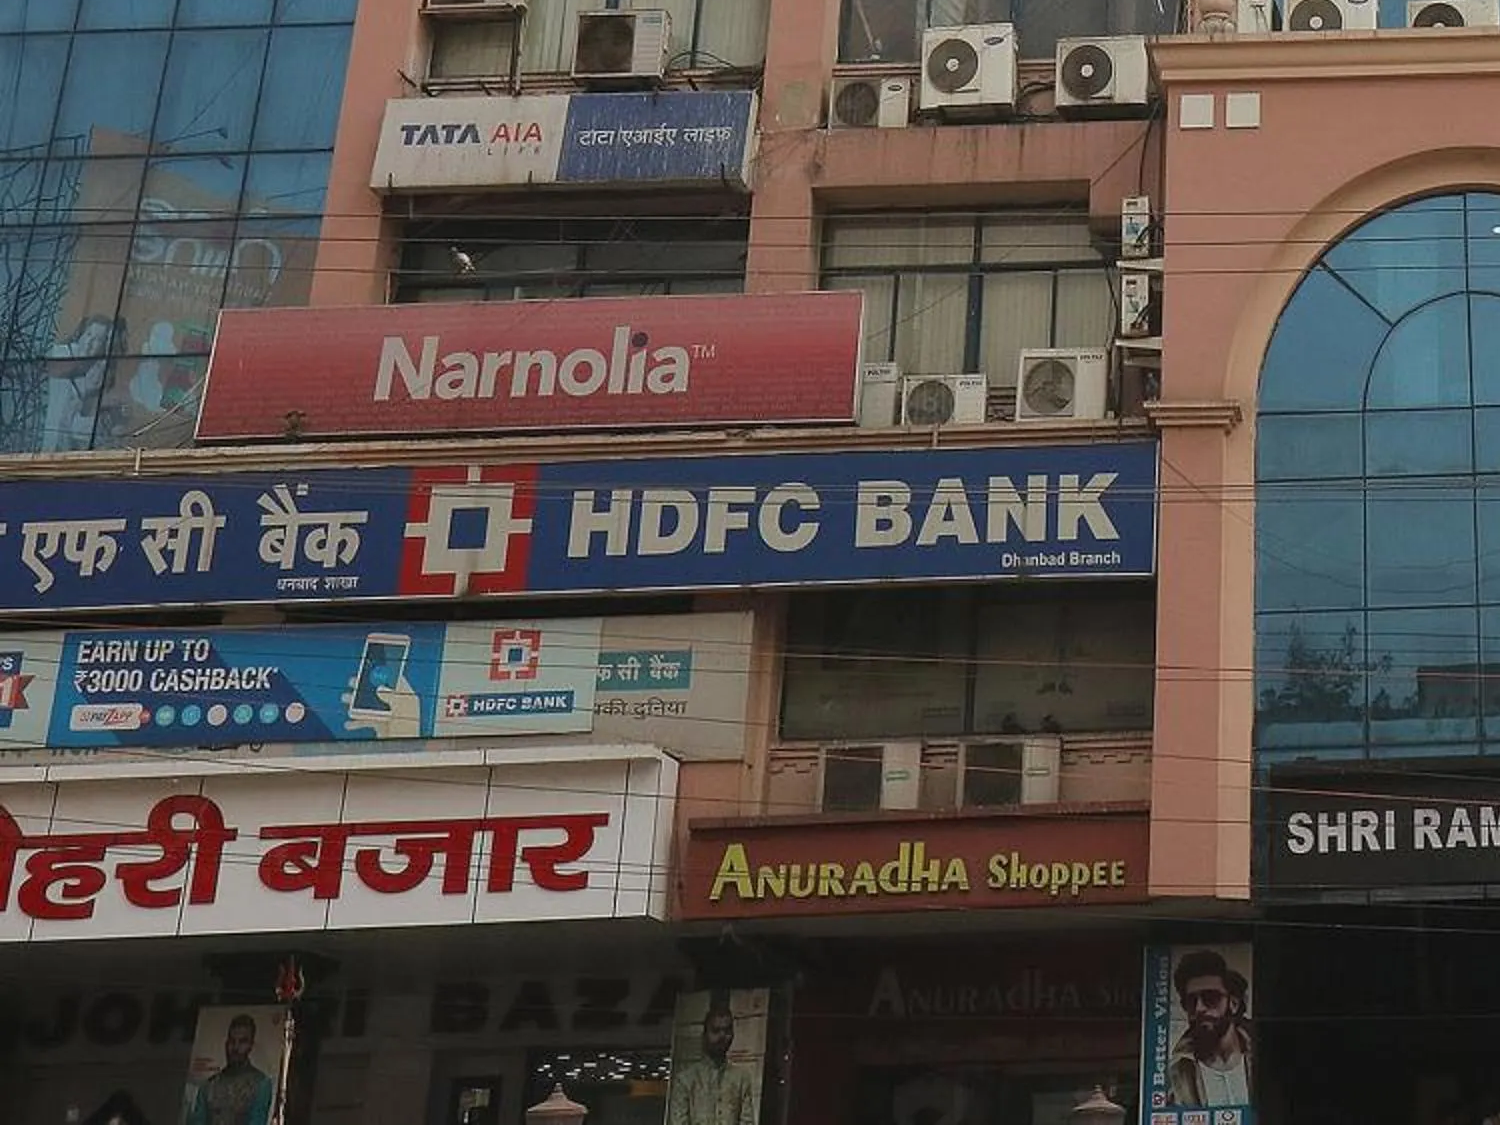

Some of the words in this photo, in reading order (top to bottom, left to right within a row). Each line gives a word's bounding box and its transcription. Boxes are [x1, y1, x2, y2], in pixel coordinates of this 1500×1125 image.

[400, 123, 481, 146] TATA
[490, 121, 542, 144] AIA
[578, 128, 615, 146] टाटा
[373, 324, 690, 402] Narnolia
[141, 490, 227, 575] सी
[256, 482, 369, 571] बैंक
[567, 482, 822, 558] HDFC
[854, 472, 1120, 549] BANK
[1069, 549, 1121, 567] Branch
[77, 640, 138, 664] EARN
[143, 640, 175, 662] UP
[182, 638, 210, 660] TO
[73, 669, 144, 693] ₹3000
[473, 697, 516, 712] HDFC
[522, 695, 568, 710] BANK
[1287, 809, 1396, 854] SHRI
[258, 813, 609, 899] बजार
[1154, 955, 1169, 1019] Vision
[1153, 1026, 1167, 1086] Better
